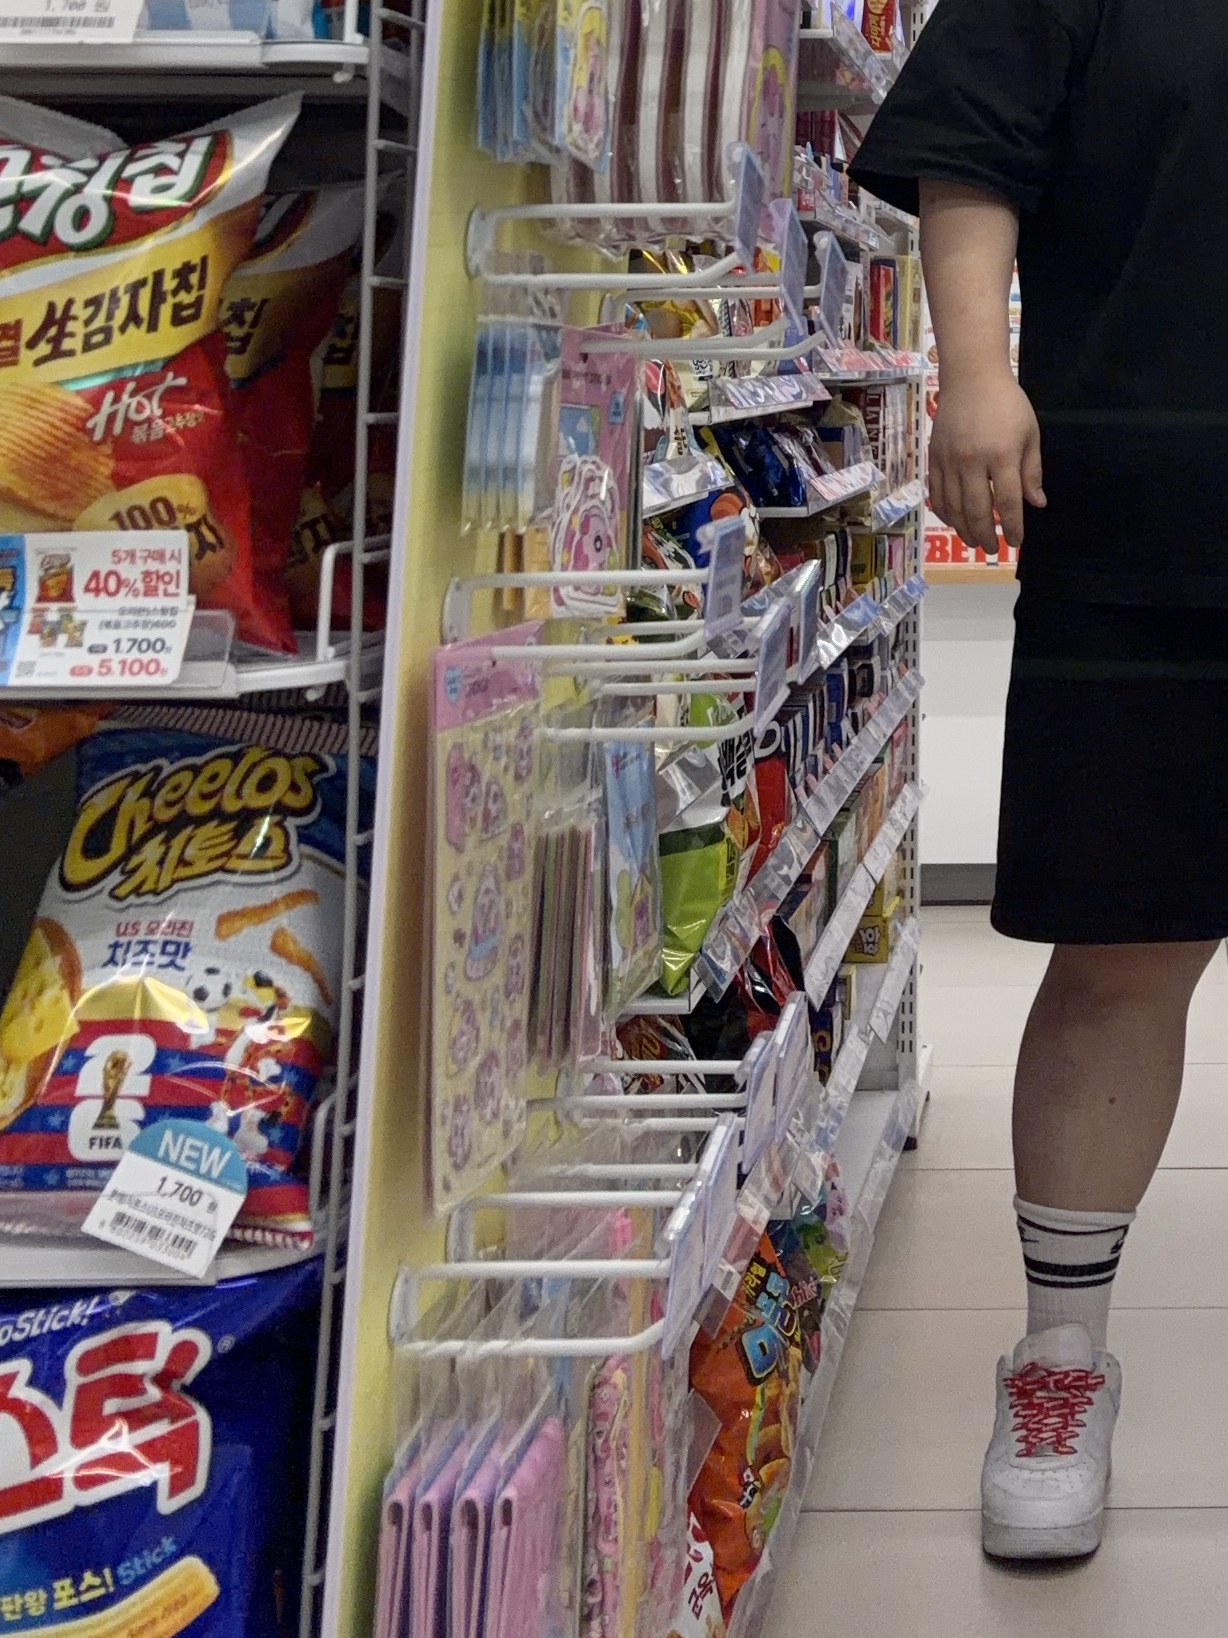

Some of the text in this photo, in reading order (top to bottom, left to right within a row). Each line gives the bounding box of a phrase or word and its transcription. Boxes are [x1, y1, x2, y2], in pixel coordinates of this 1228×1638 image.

[44, 0, 87, 12] 1,700
[25, 254, 209, 366] 生감자칩
[87, 371, 188, 444] Hot
[63, 748, 317, 890] Cheetos
[110, 812, 291, 900] 치토스
[101, 939, 194, 972] 치즈맛
[88, 1135, 123, 1151] FIFA
[156, 1127, 233, 1181] NEW
[156, 1175, 204, 1208] 1,700
[117, 1534, 180, 1587] Stick
